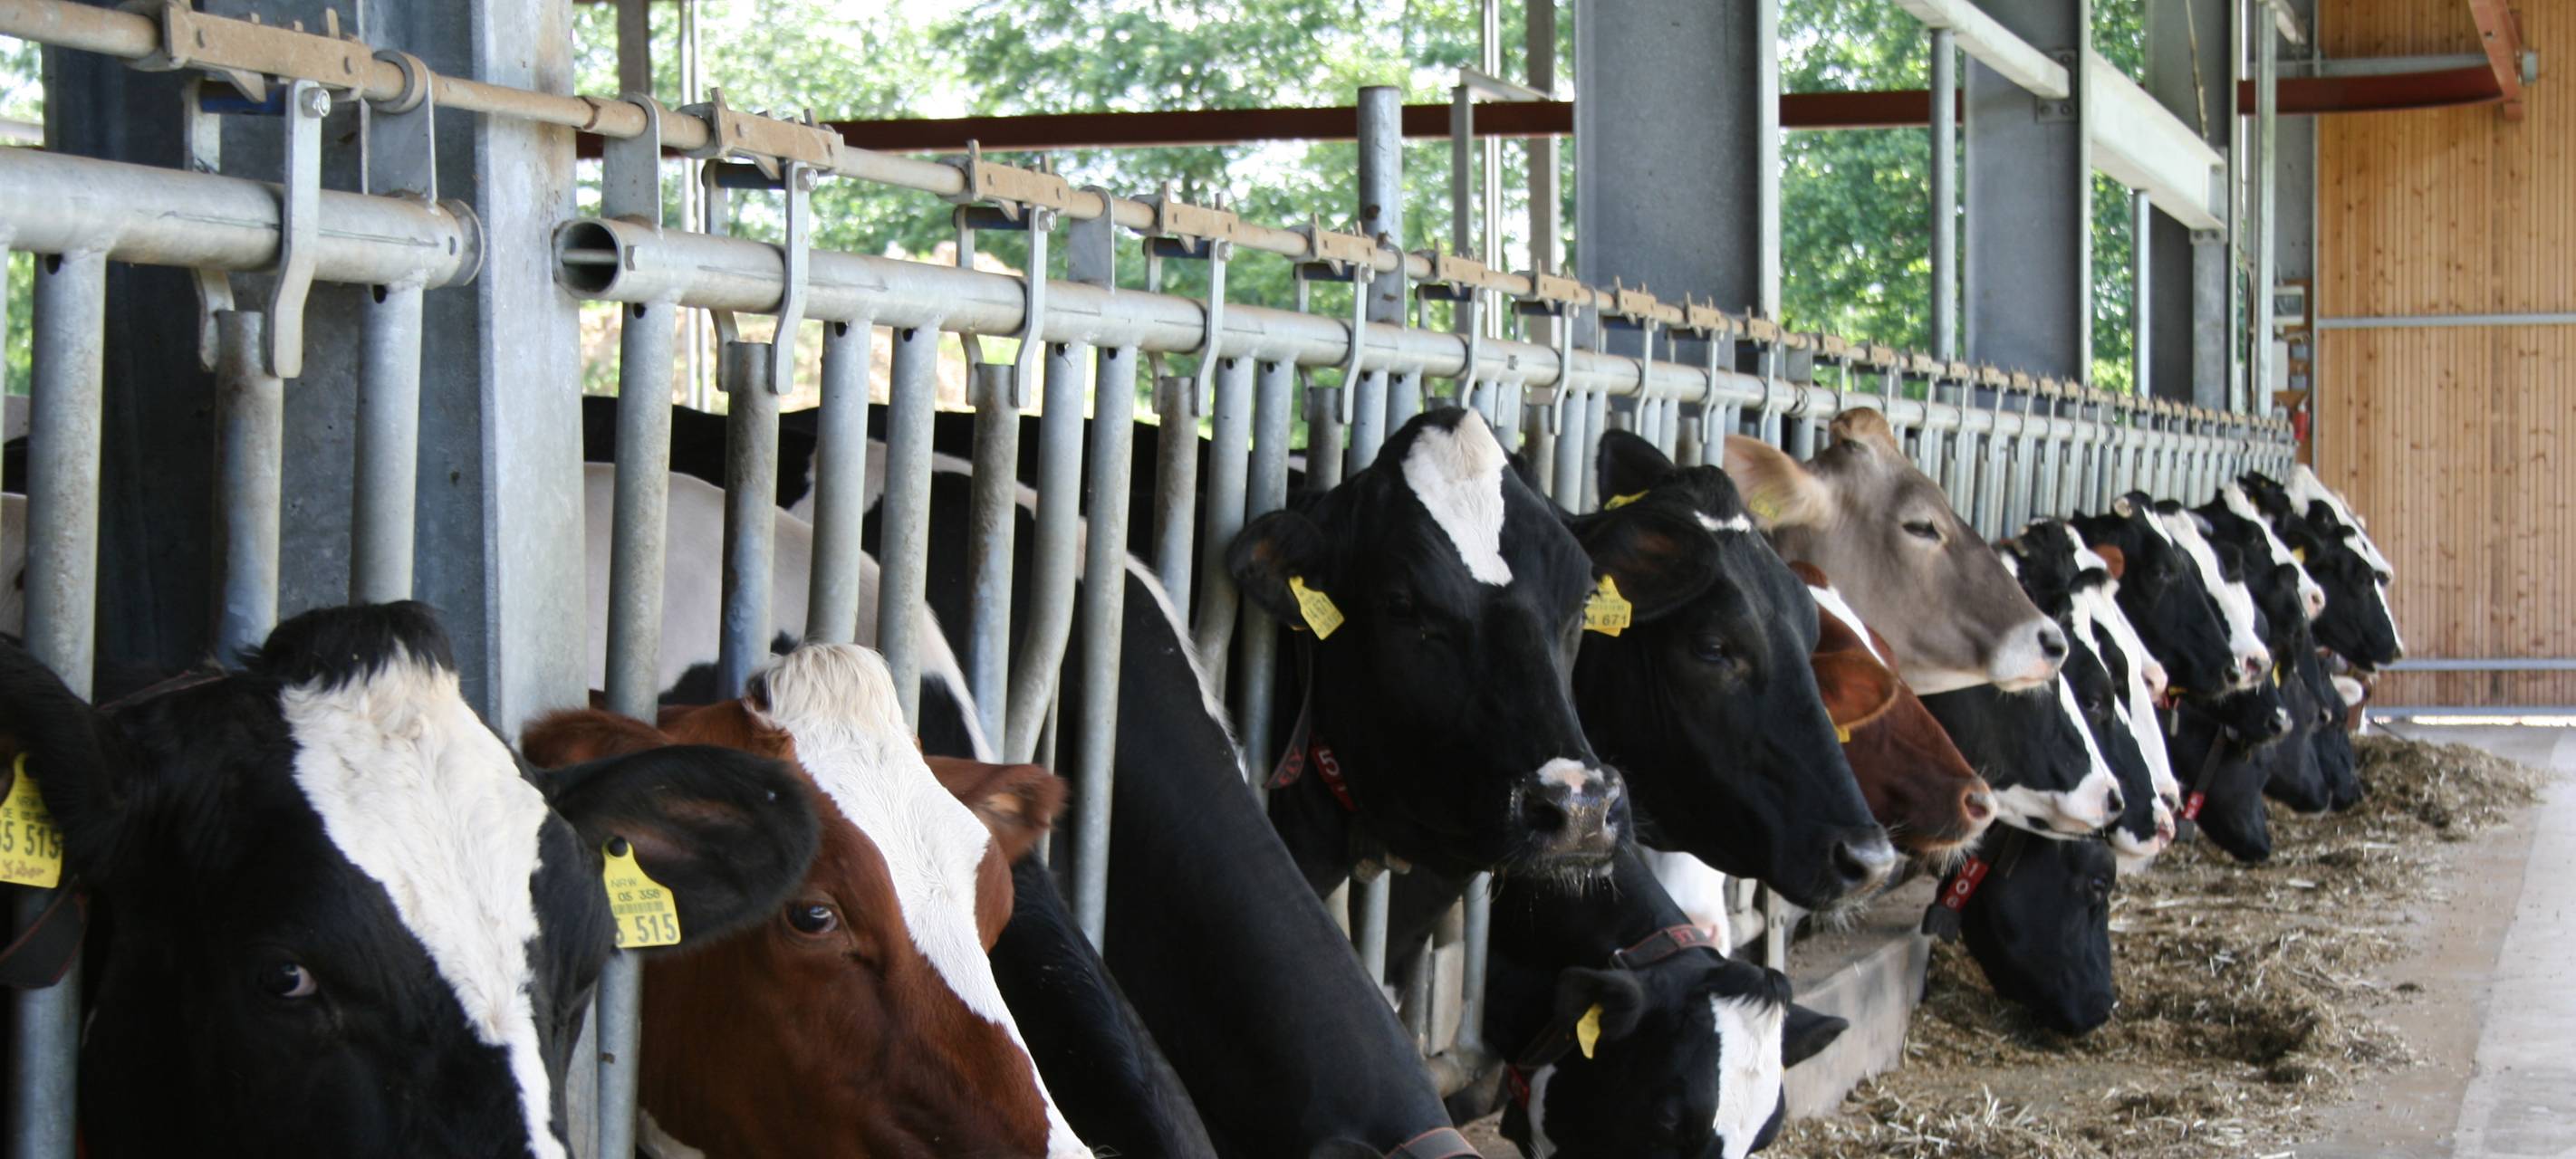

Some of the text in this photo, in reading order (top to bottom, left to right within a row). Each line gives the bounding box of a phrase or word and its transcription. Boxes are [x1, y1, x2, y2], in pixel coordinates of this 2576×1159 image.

[1602, 613, 1627, 626] 671
[24, 824, 61, 859] 515
[635, 913, 677, 943] 515
